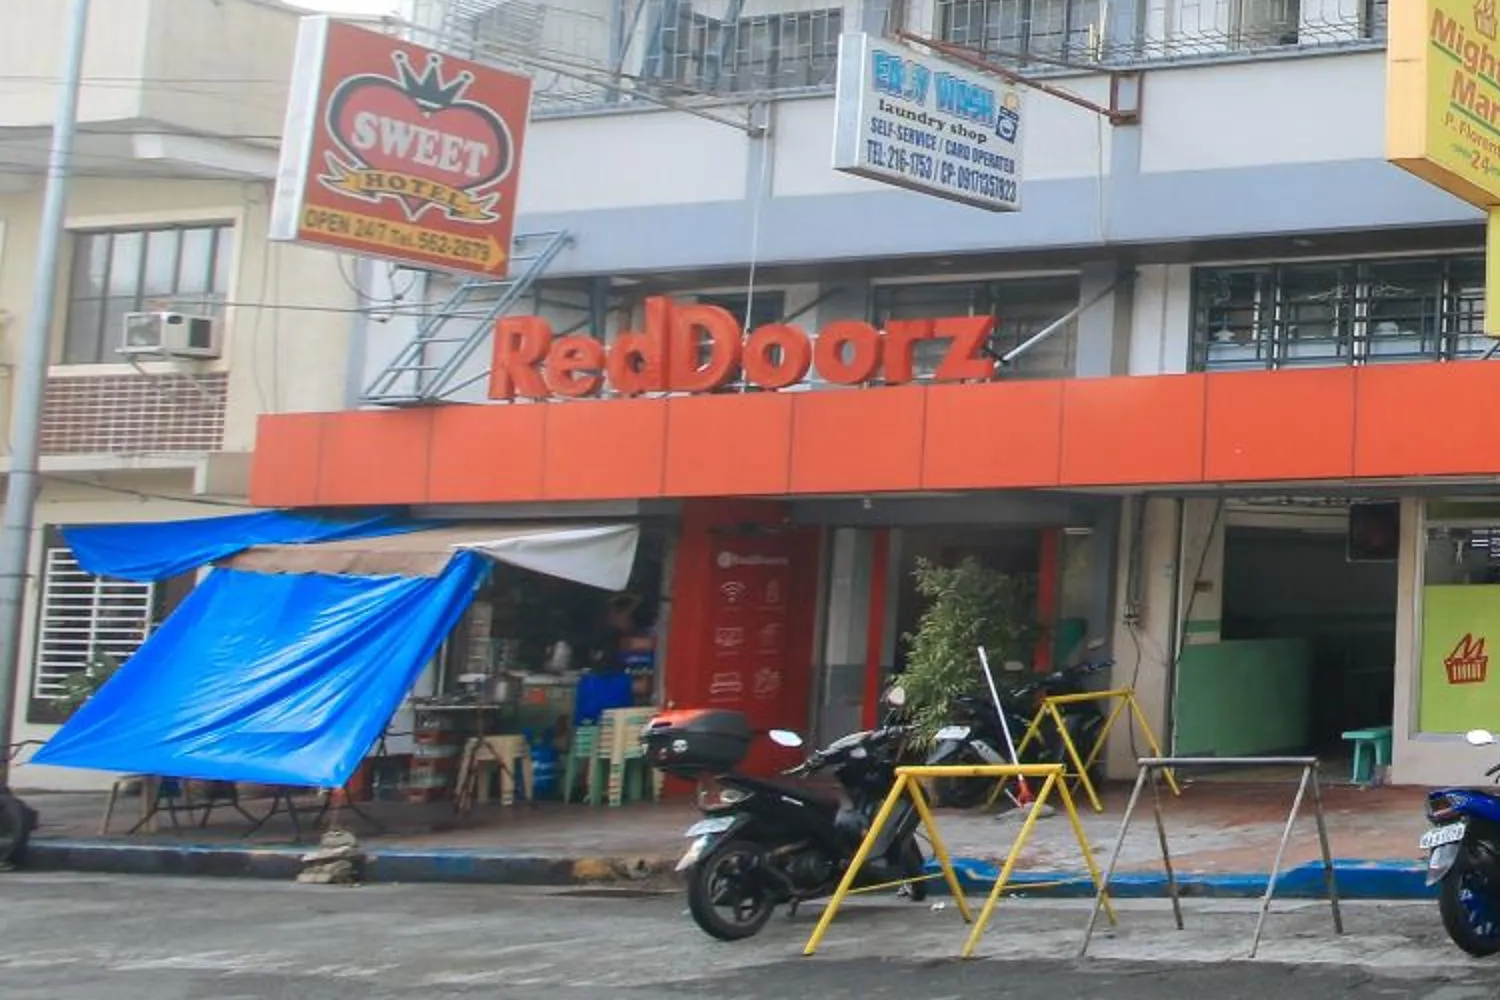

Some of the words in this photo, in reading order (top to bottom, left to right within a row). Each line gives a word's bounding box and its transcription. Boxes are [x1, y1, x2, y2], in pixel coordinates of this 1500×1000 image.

[880, 99, 945, 130] laundry
[951, 123, 987, 145] shop
[352, 112, 489, 177] SWEET
[1471, 149, 1490, 174] 24
[365, 173, 461, 203] HOTEL
[306, 209, 350, 234] OPEN
[489, 296, 995, 398] RedDoorz
